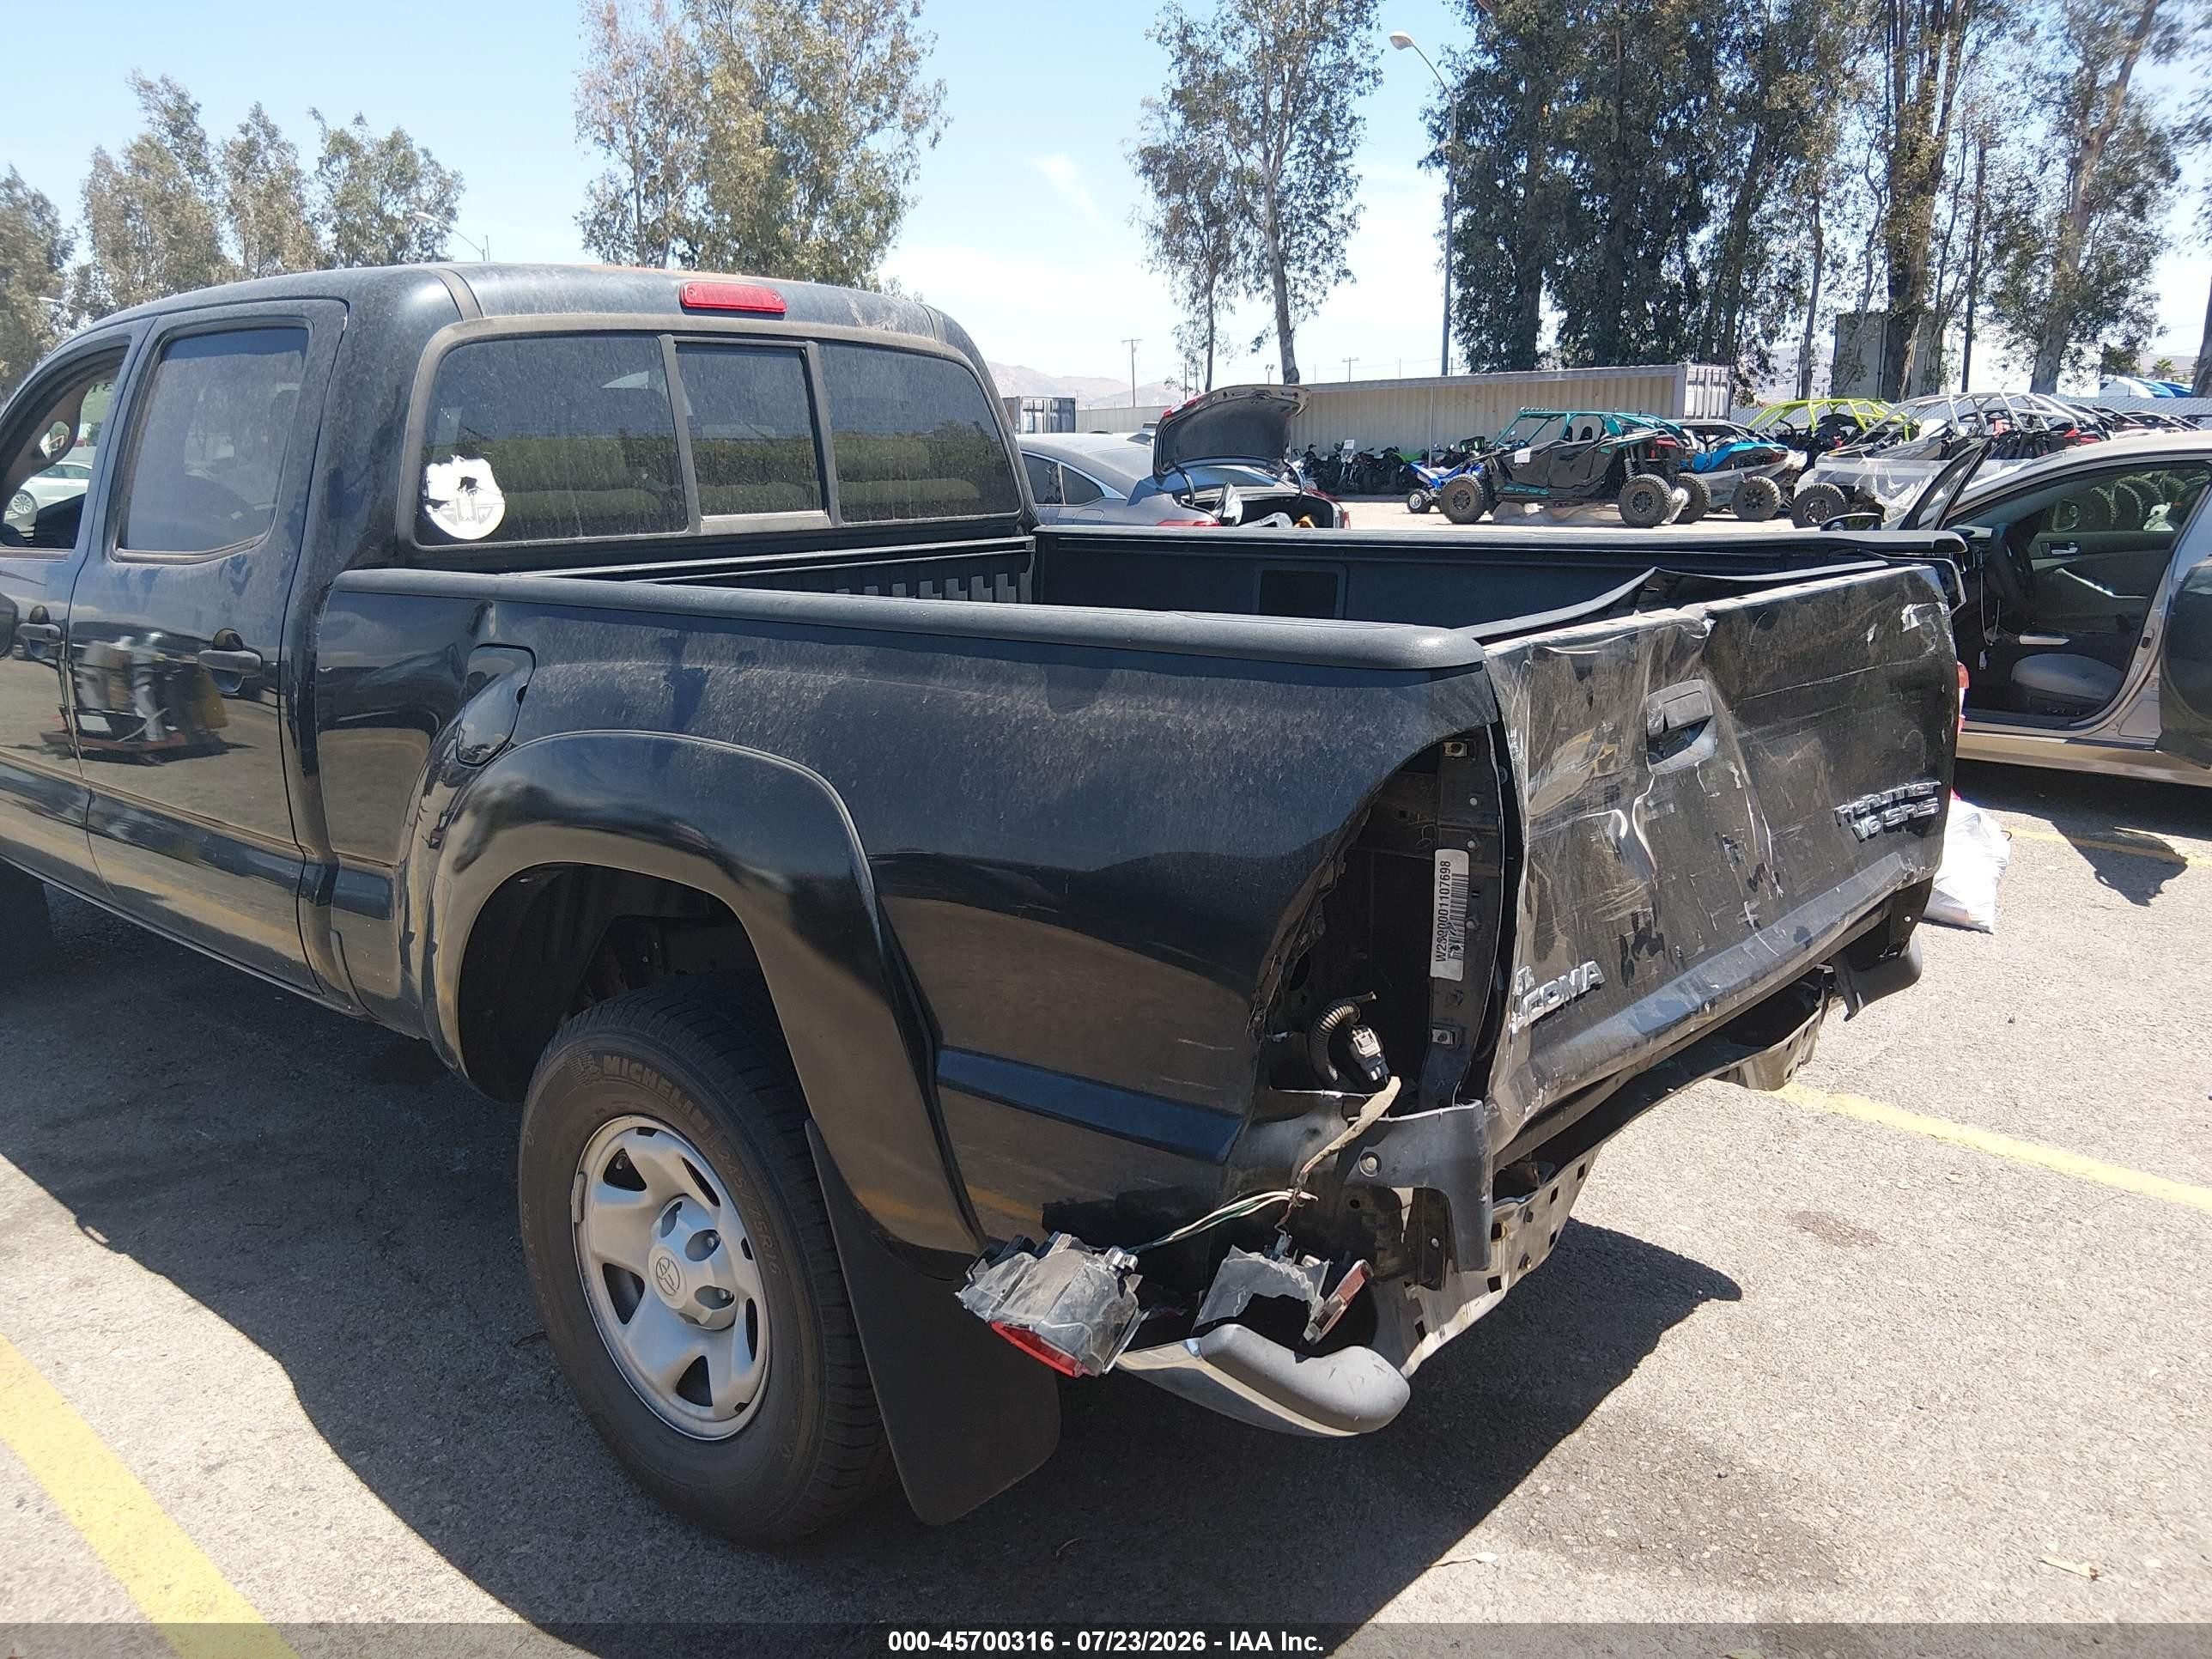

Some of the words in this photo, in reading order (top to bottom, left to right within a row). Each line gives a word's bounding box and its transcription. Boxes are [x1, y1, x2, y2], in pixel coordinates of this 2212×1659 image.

[1851, 815, 1881, 841] V6
[1883, 798, 1940, 829] SR5
[603, 1054, 712, 1133] MICHELIN
